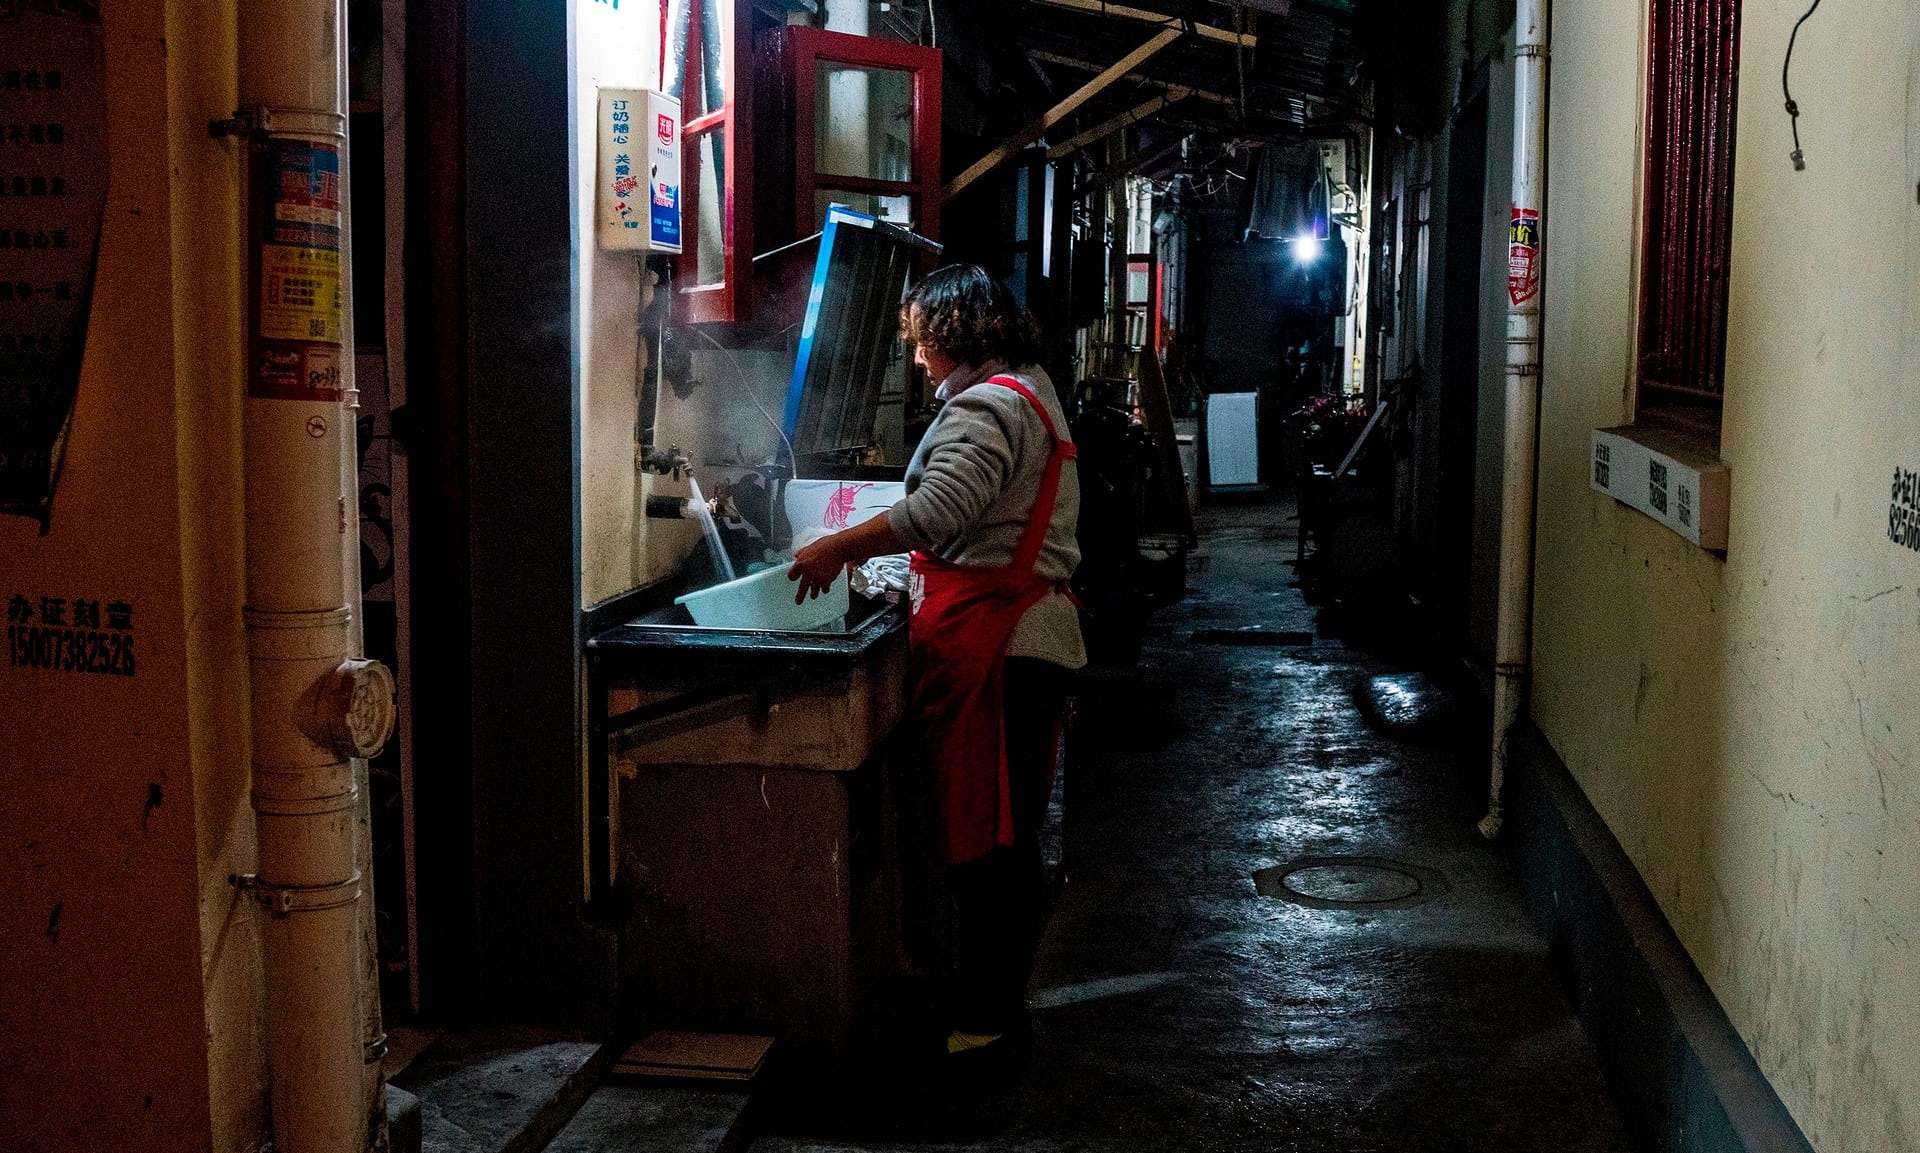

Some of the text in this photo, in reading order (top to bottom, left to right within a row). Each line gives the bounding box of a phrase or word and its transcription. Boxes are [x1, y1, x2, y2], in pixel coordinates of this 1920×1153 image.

[612, 100, 630, 144] 订奶随心
[7, 594, 135, 631] 办证刻章
[8, 626, 136, 677] 15007382526
